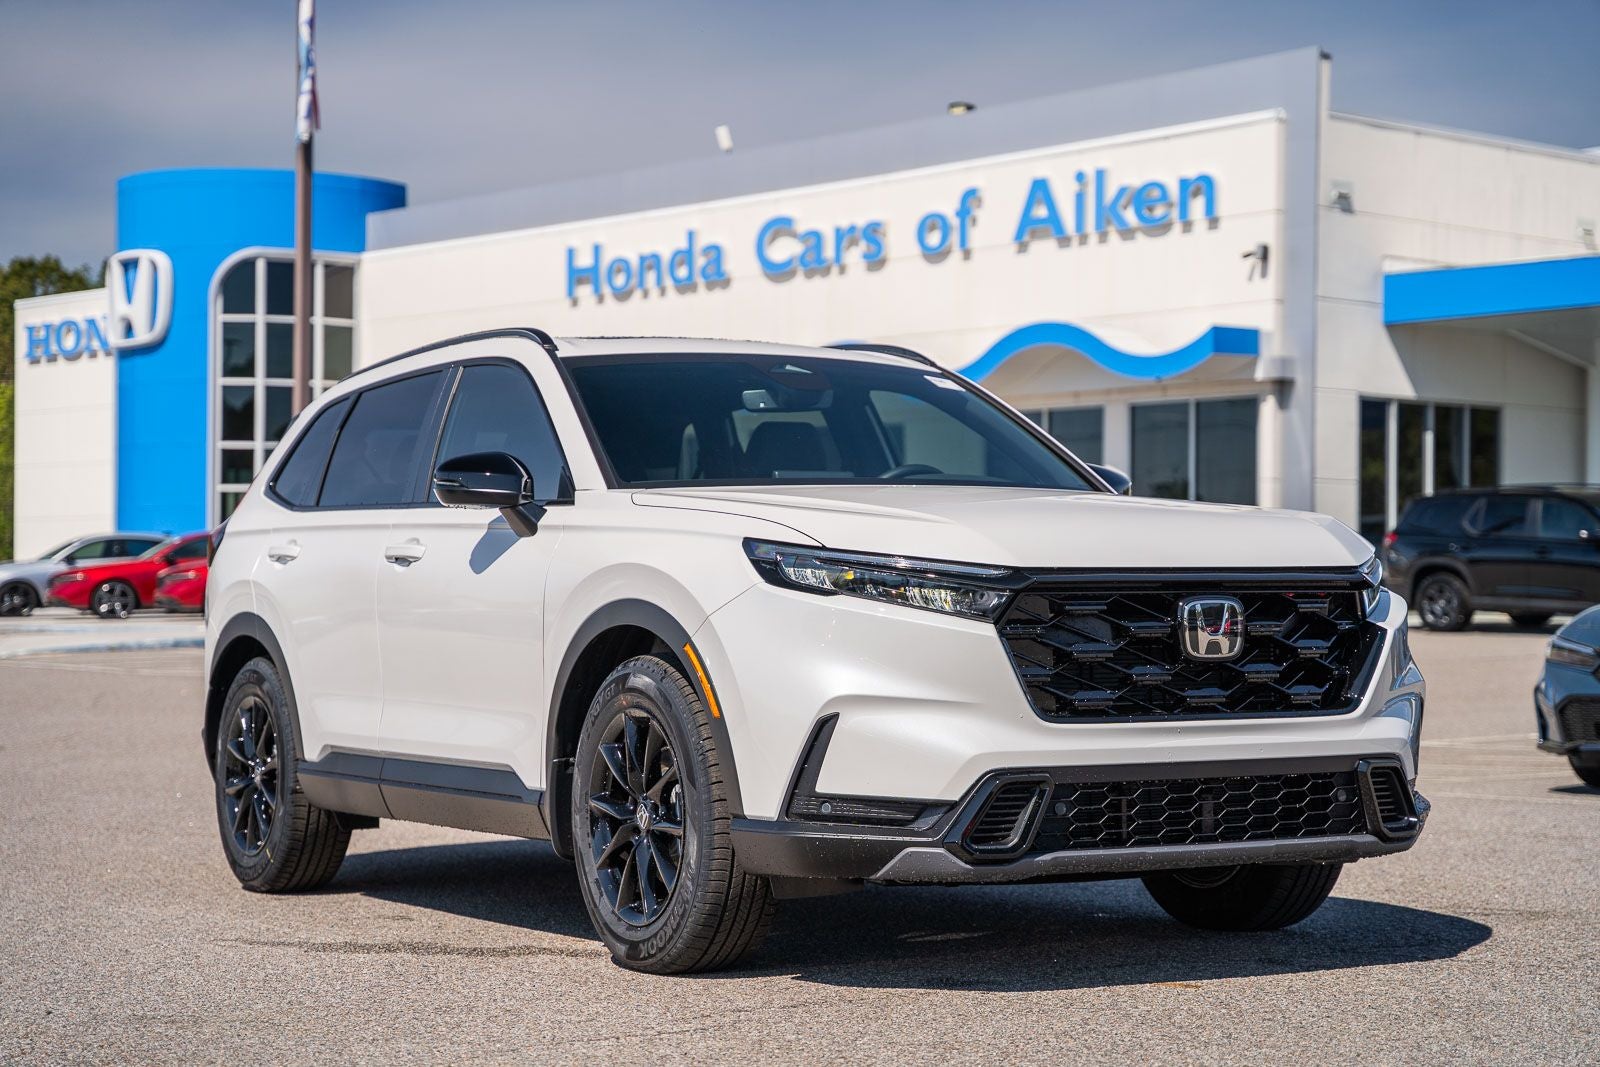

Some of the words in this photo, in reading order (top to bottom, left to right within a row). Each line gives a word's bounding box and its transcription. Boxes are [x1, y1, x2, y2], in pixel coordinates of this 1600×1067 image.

[566, 230, 727, 298] Honda
[755, 215, 885, 275] Cars
[916, 187, 978, 255] of
[1013, 168, 1217, 243] Aiken
